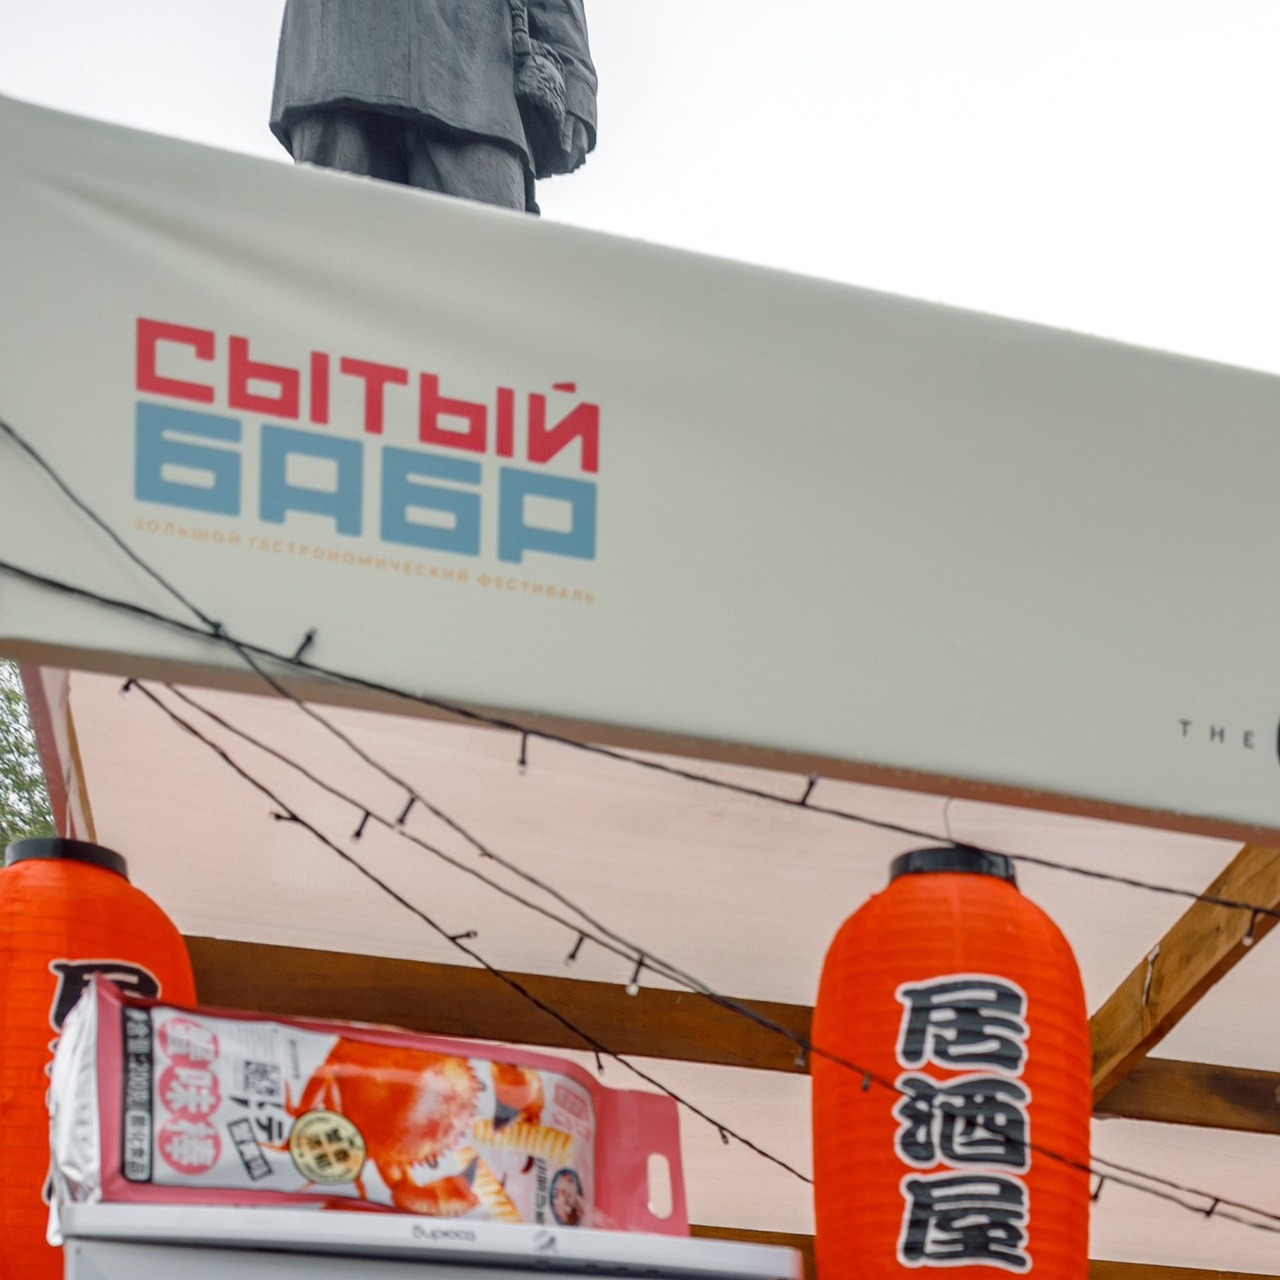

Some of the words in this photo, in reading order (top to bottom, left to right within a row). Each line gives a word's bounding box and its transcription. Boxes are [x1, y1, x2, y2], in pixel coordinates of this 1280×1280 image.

[136, 317, 600, 474] СЫТЫЙ
[134, 400, 598, 565] БАБР
[134, 516, 242, 547] БОЛЬШОЙ
[248, 534, 471, 584] ГАСТРОНОМИЧЕСКИЙ
[477, 572, 597, 605] ФЕСТИВАЛЬ
[1179, 719, 1255, 749] THE
[893, 973, 1031, 1274] 居酒屋
